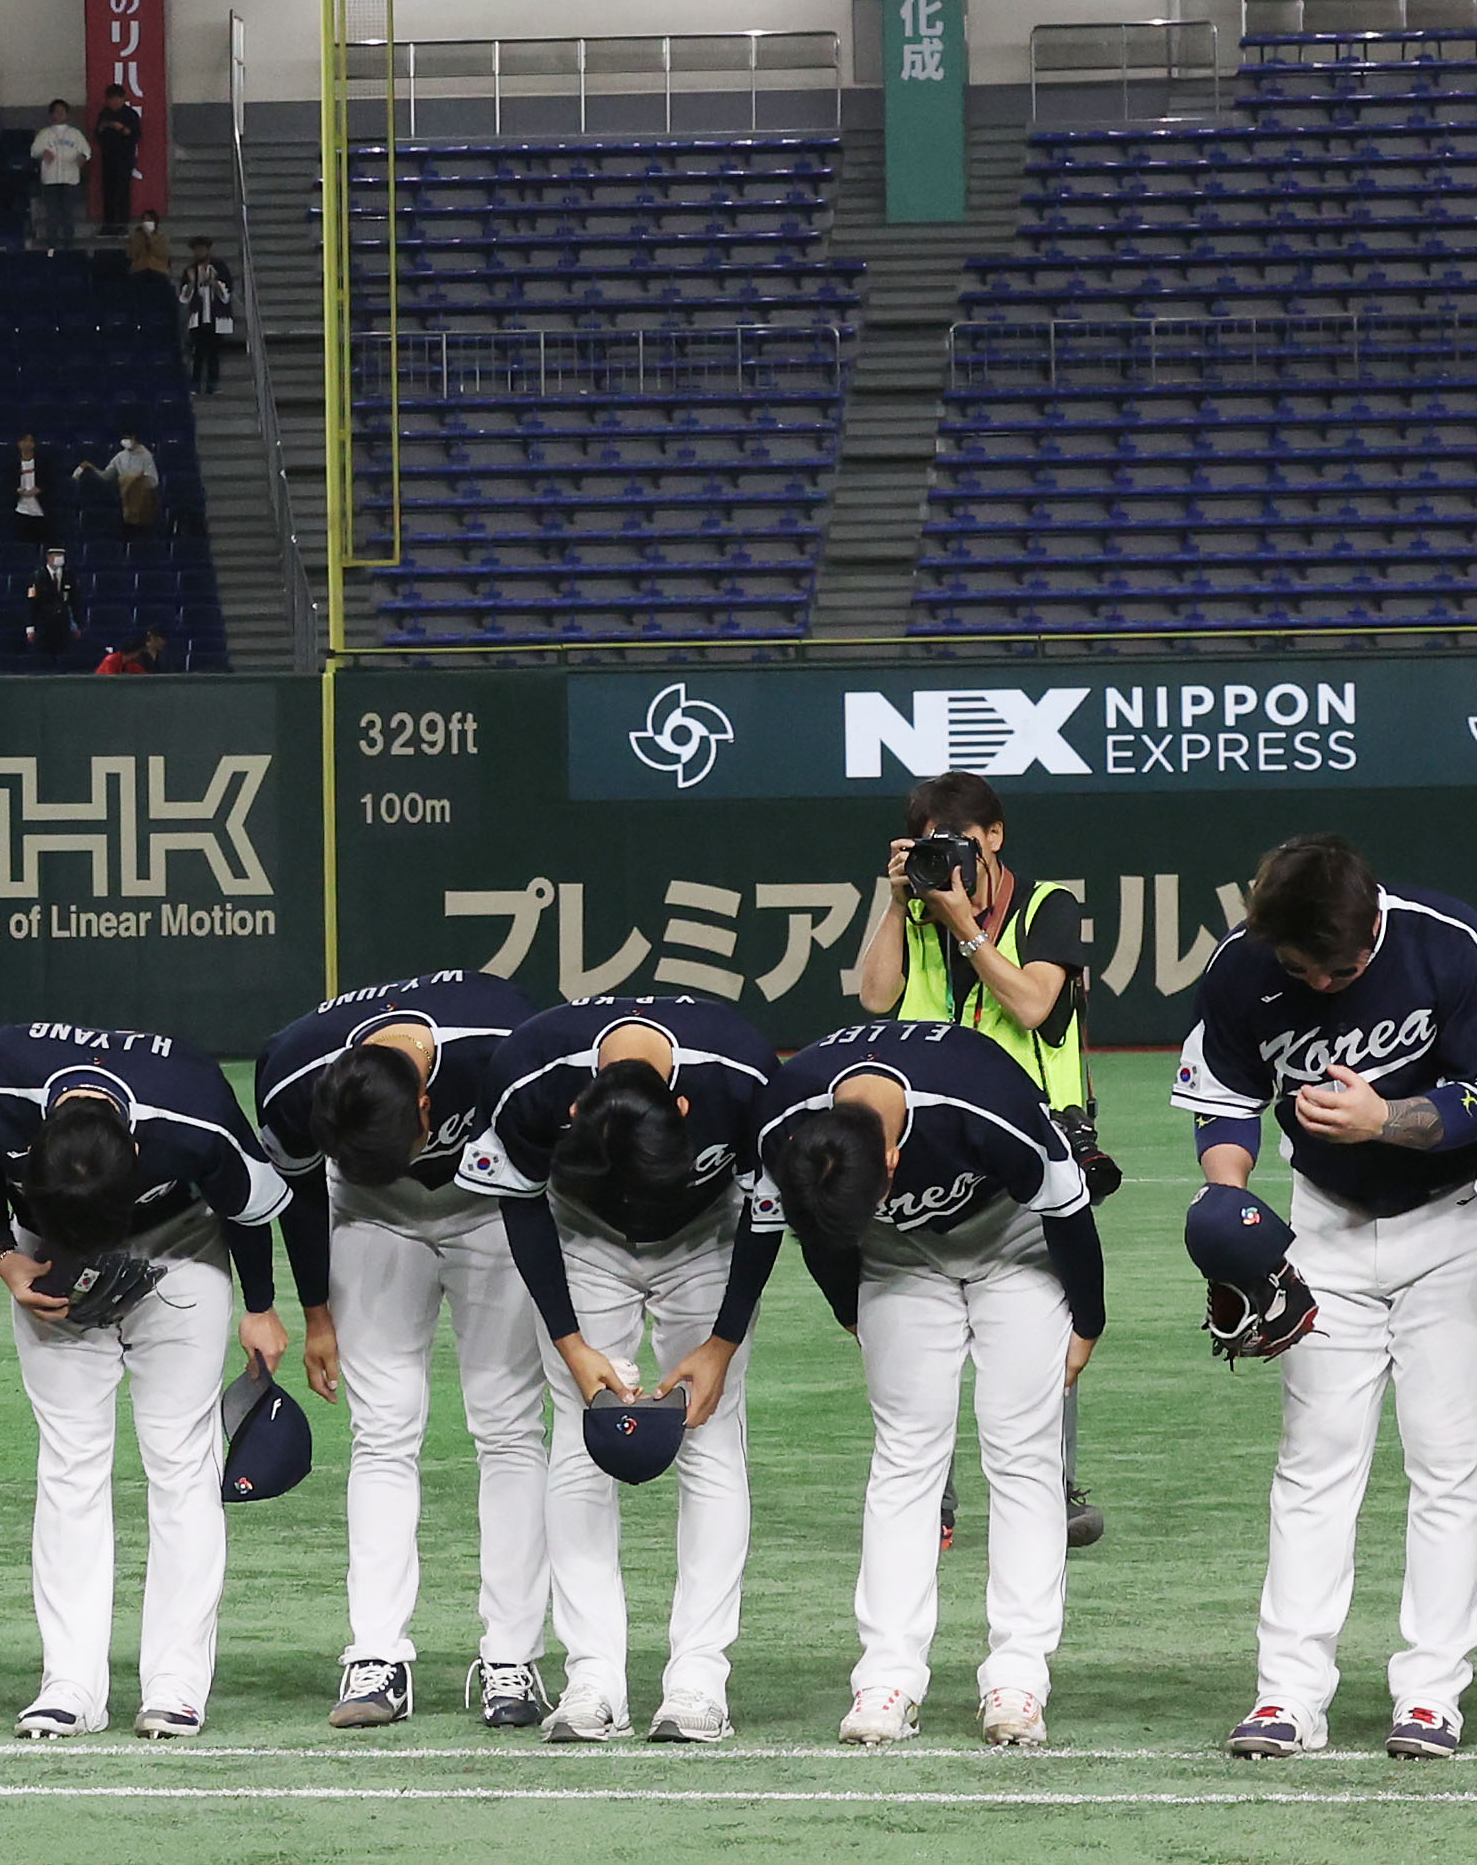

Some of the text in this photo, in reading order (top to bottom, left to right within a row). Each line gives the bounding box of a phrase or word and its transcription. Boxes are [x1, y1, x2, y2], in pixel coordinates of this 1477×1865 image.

[1104, 683, 1358, 729] NIPPON
[358, 711, 479, 758] 329ft
[845, 688, 1092, 779] NX
[1104, 730, 1358, 774] EXPRESS
[359, 792, 452, 825] 100m
[8, 904, 42, 942] of
[52, 903, 152, 940] Linear
[160, 903, 276, 938] Motion
[28, 1021, 111, 1050] YANG
[150, 1034, 173, 1057] H
[1259, 1007, 1438, 1092] Korea
